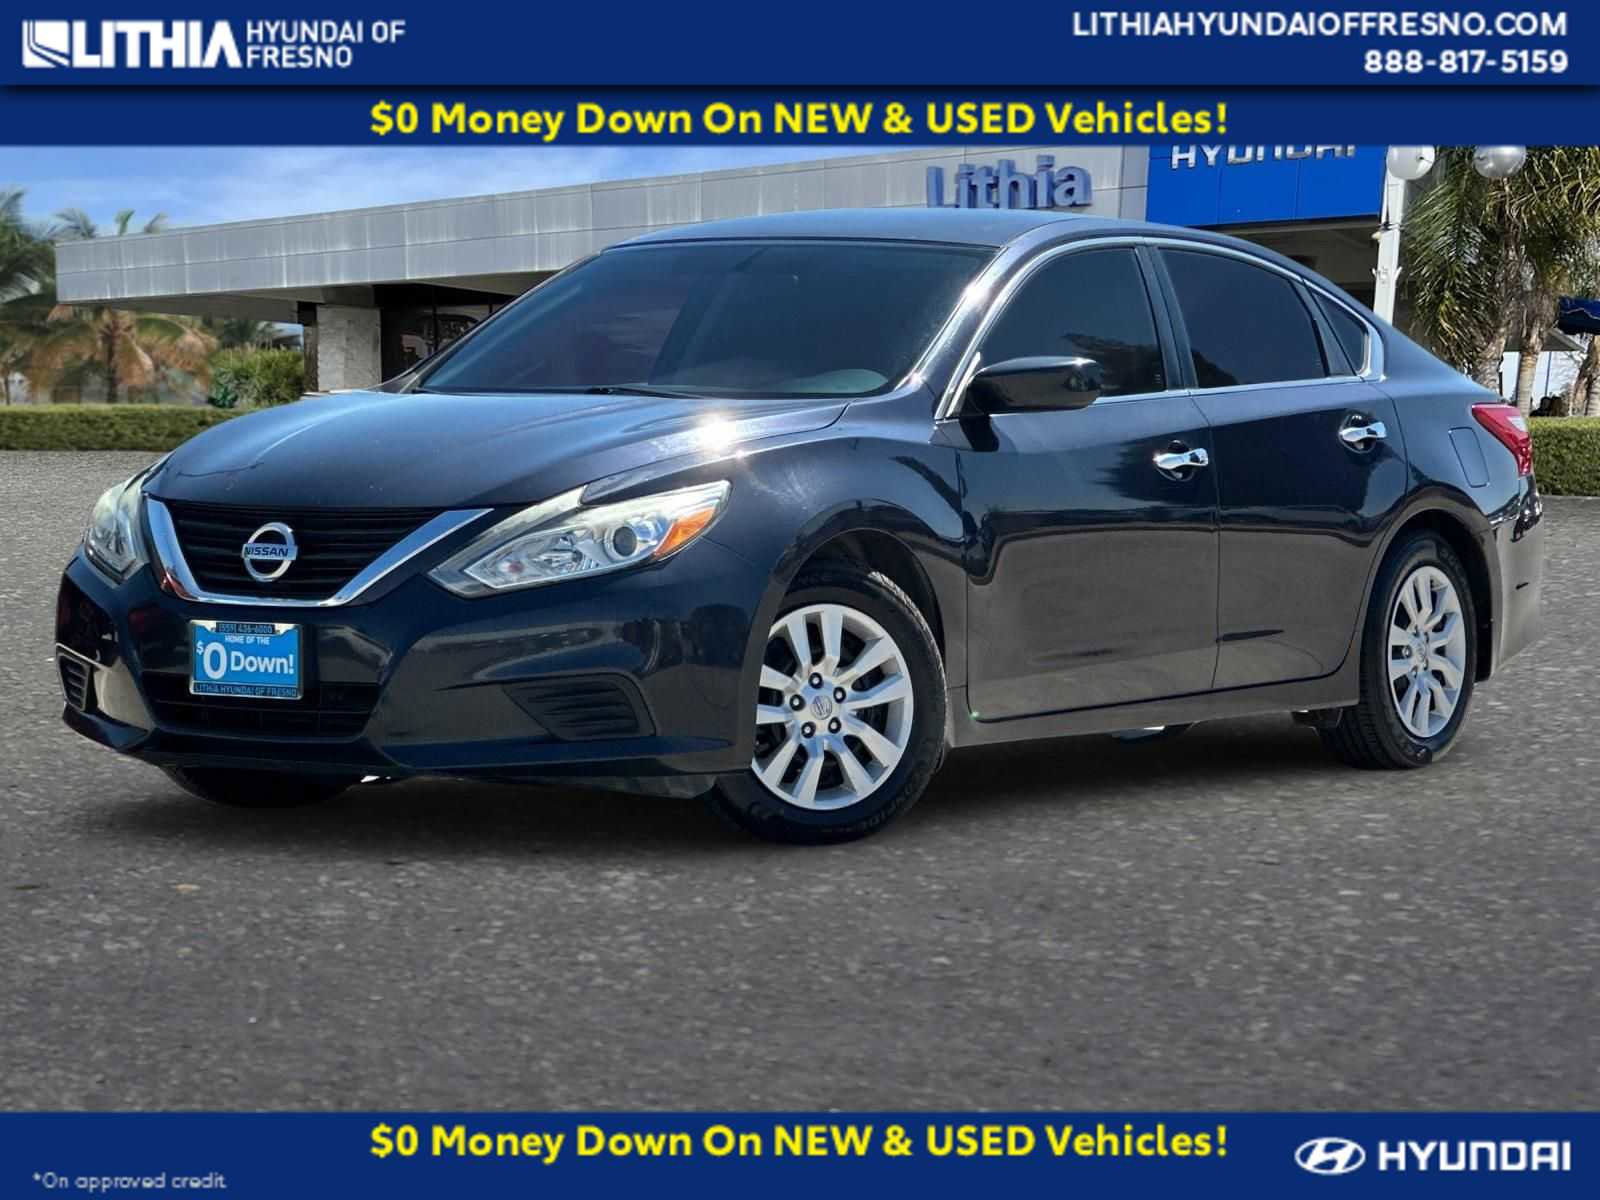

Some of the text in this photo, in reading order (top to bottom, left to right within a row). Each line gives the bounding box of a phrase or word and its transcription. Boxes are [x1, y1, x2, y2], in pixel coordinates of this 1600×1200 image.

[926, 154, 1093, 209] Lithia
[245, 546, 289, 558] NISSAN
[224, 633, 270, 646] HOME OF THE
[231, 650, 294, 675] Down!
